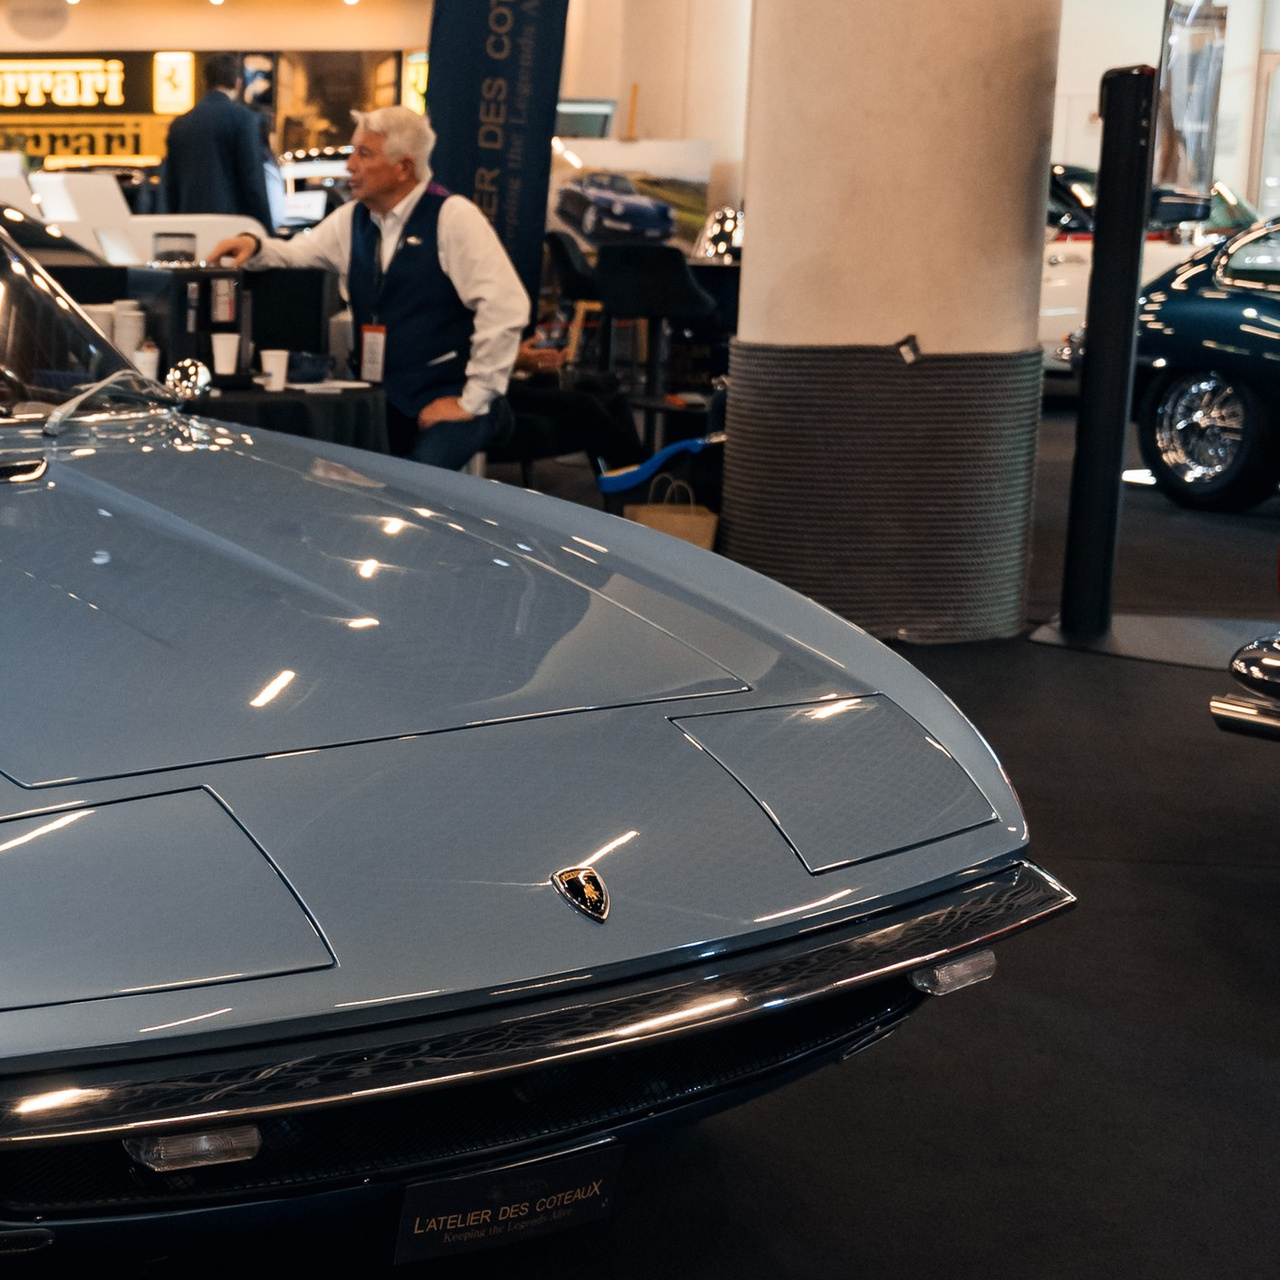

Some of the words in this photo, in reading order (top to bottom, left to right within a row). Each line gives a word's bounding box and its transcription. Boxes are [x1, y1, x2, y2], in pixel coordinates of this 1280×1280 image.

[478, 78, 508, 150] DES
[413, 1209, 492, 1235] L'ATELIER
[498, 1202, 530, 1221] DES
[535, 1179, 604, 1213] COTEAUX
